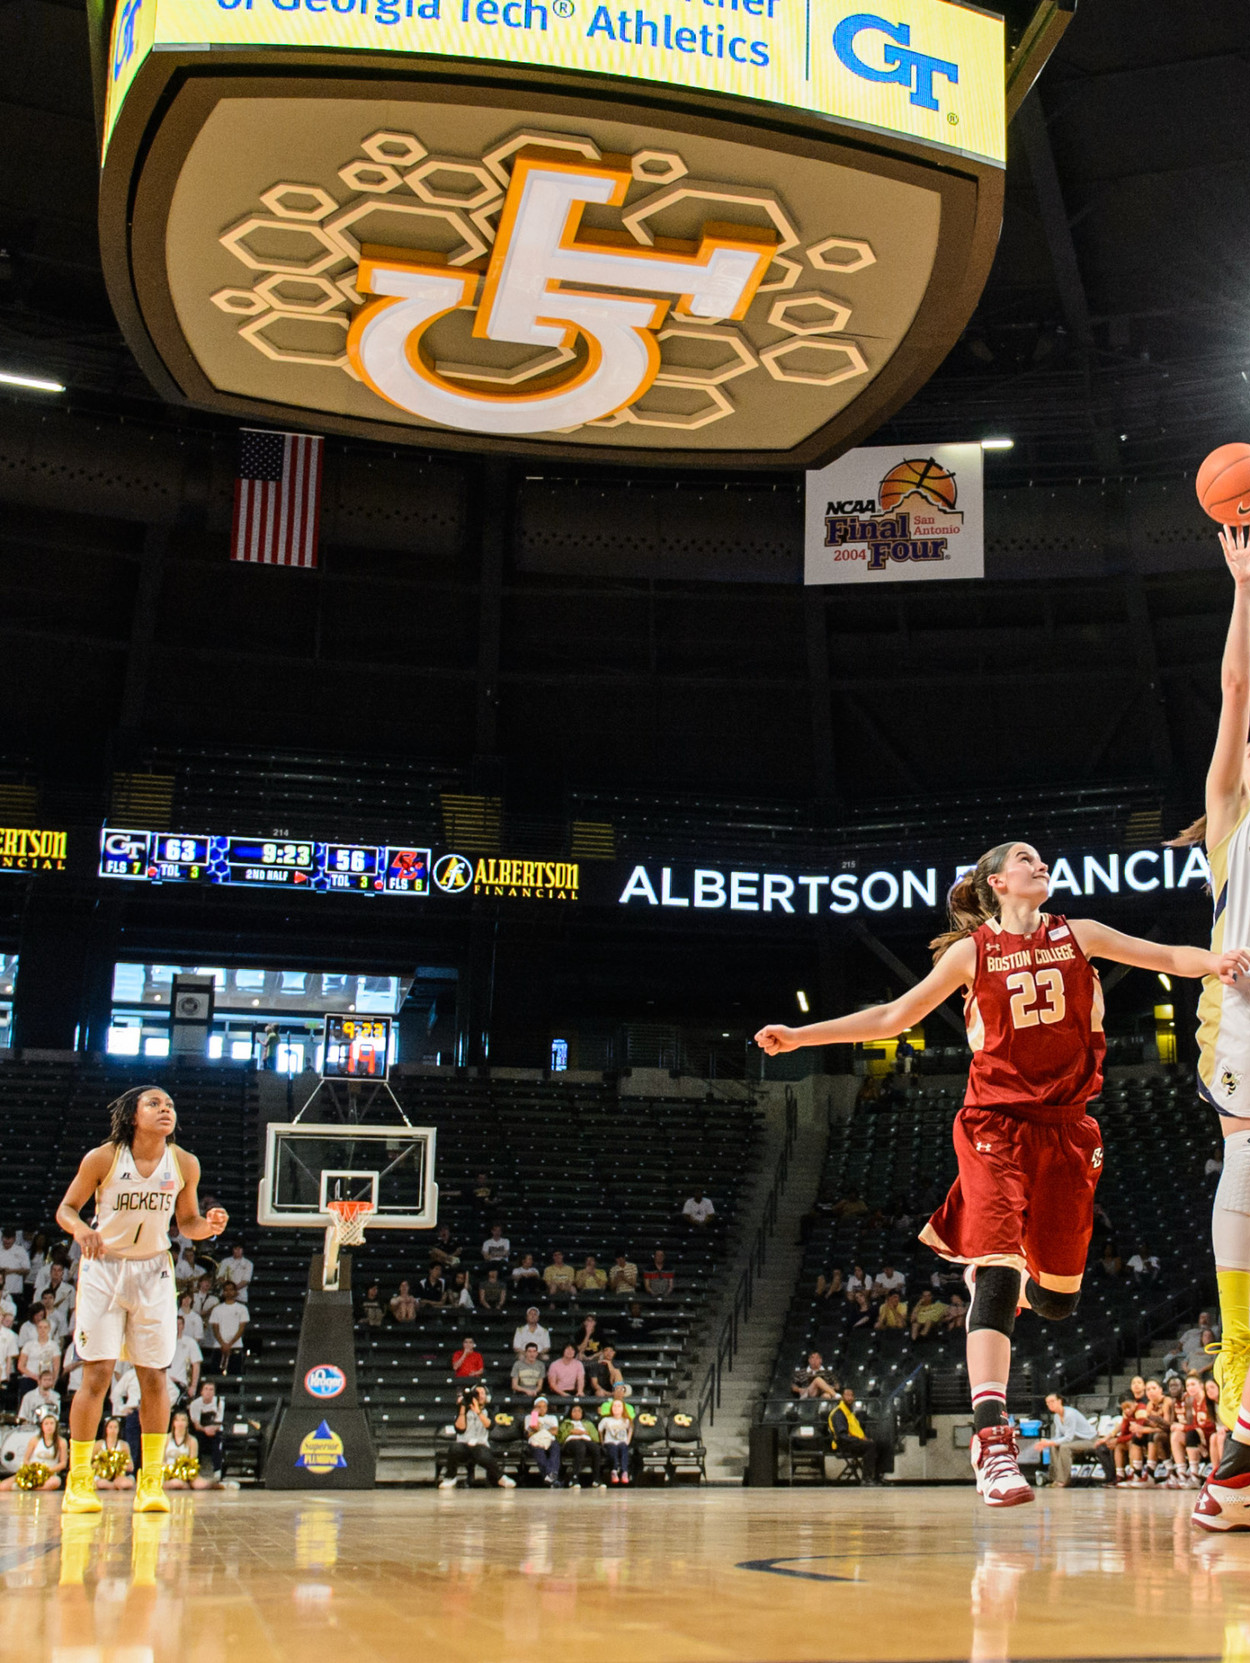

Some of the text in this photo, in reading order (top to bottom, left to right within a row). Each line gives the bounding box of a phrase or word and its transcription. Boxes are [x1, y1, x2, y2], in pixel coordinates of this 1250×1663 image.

[586, 5, 770, 67] Athletics
[832, 13, 958, 111] GT
[825, 500, 876, 515] NCAA
[825, 513, 911, 547] Final
[913, 515, 935, 526] San
[913, 525, 961, 536] Antonio
[833, 538, 947, 571] 2004 Four
[165, 839, 196, 861] 63
[262, 843, 310, 866] 9:23
[336, 850, 365, 872] 56
[106, 860, 142, 874] FLS 7
[161, 864, 199, 878] TOL 3
[245, 869, 289, 882] 2ND HALF
[474, 858, 579, 890] ALBERTSON
[331, 874, 368, 888] TOL 3
[389, 877, 422, 891] FLS 6
[474, 884, 579, 900] FINANCIAL
[618, 865, 937, 914] ALBERTSON
[987, 943, 1076, 973] BOSTON COLLEGE
[1006, 968, 1066, 1030] 23
[342, 1021, 384, 1039] 9:23
[112, 1192, 173, 1211] JACKETS
[133, 1221, 144, 1245] 1
